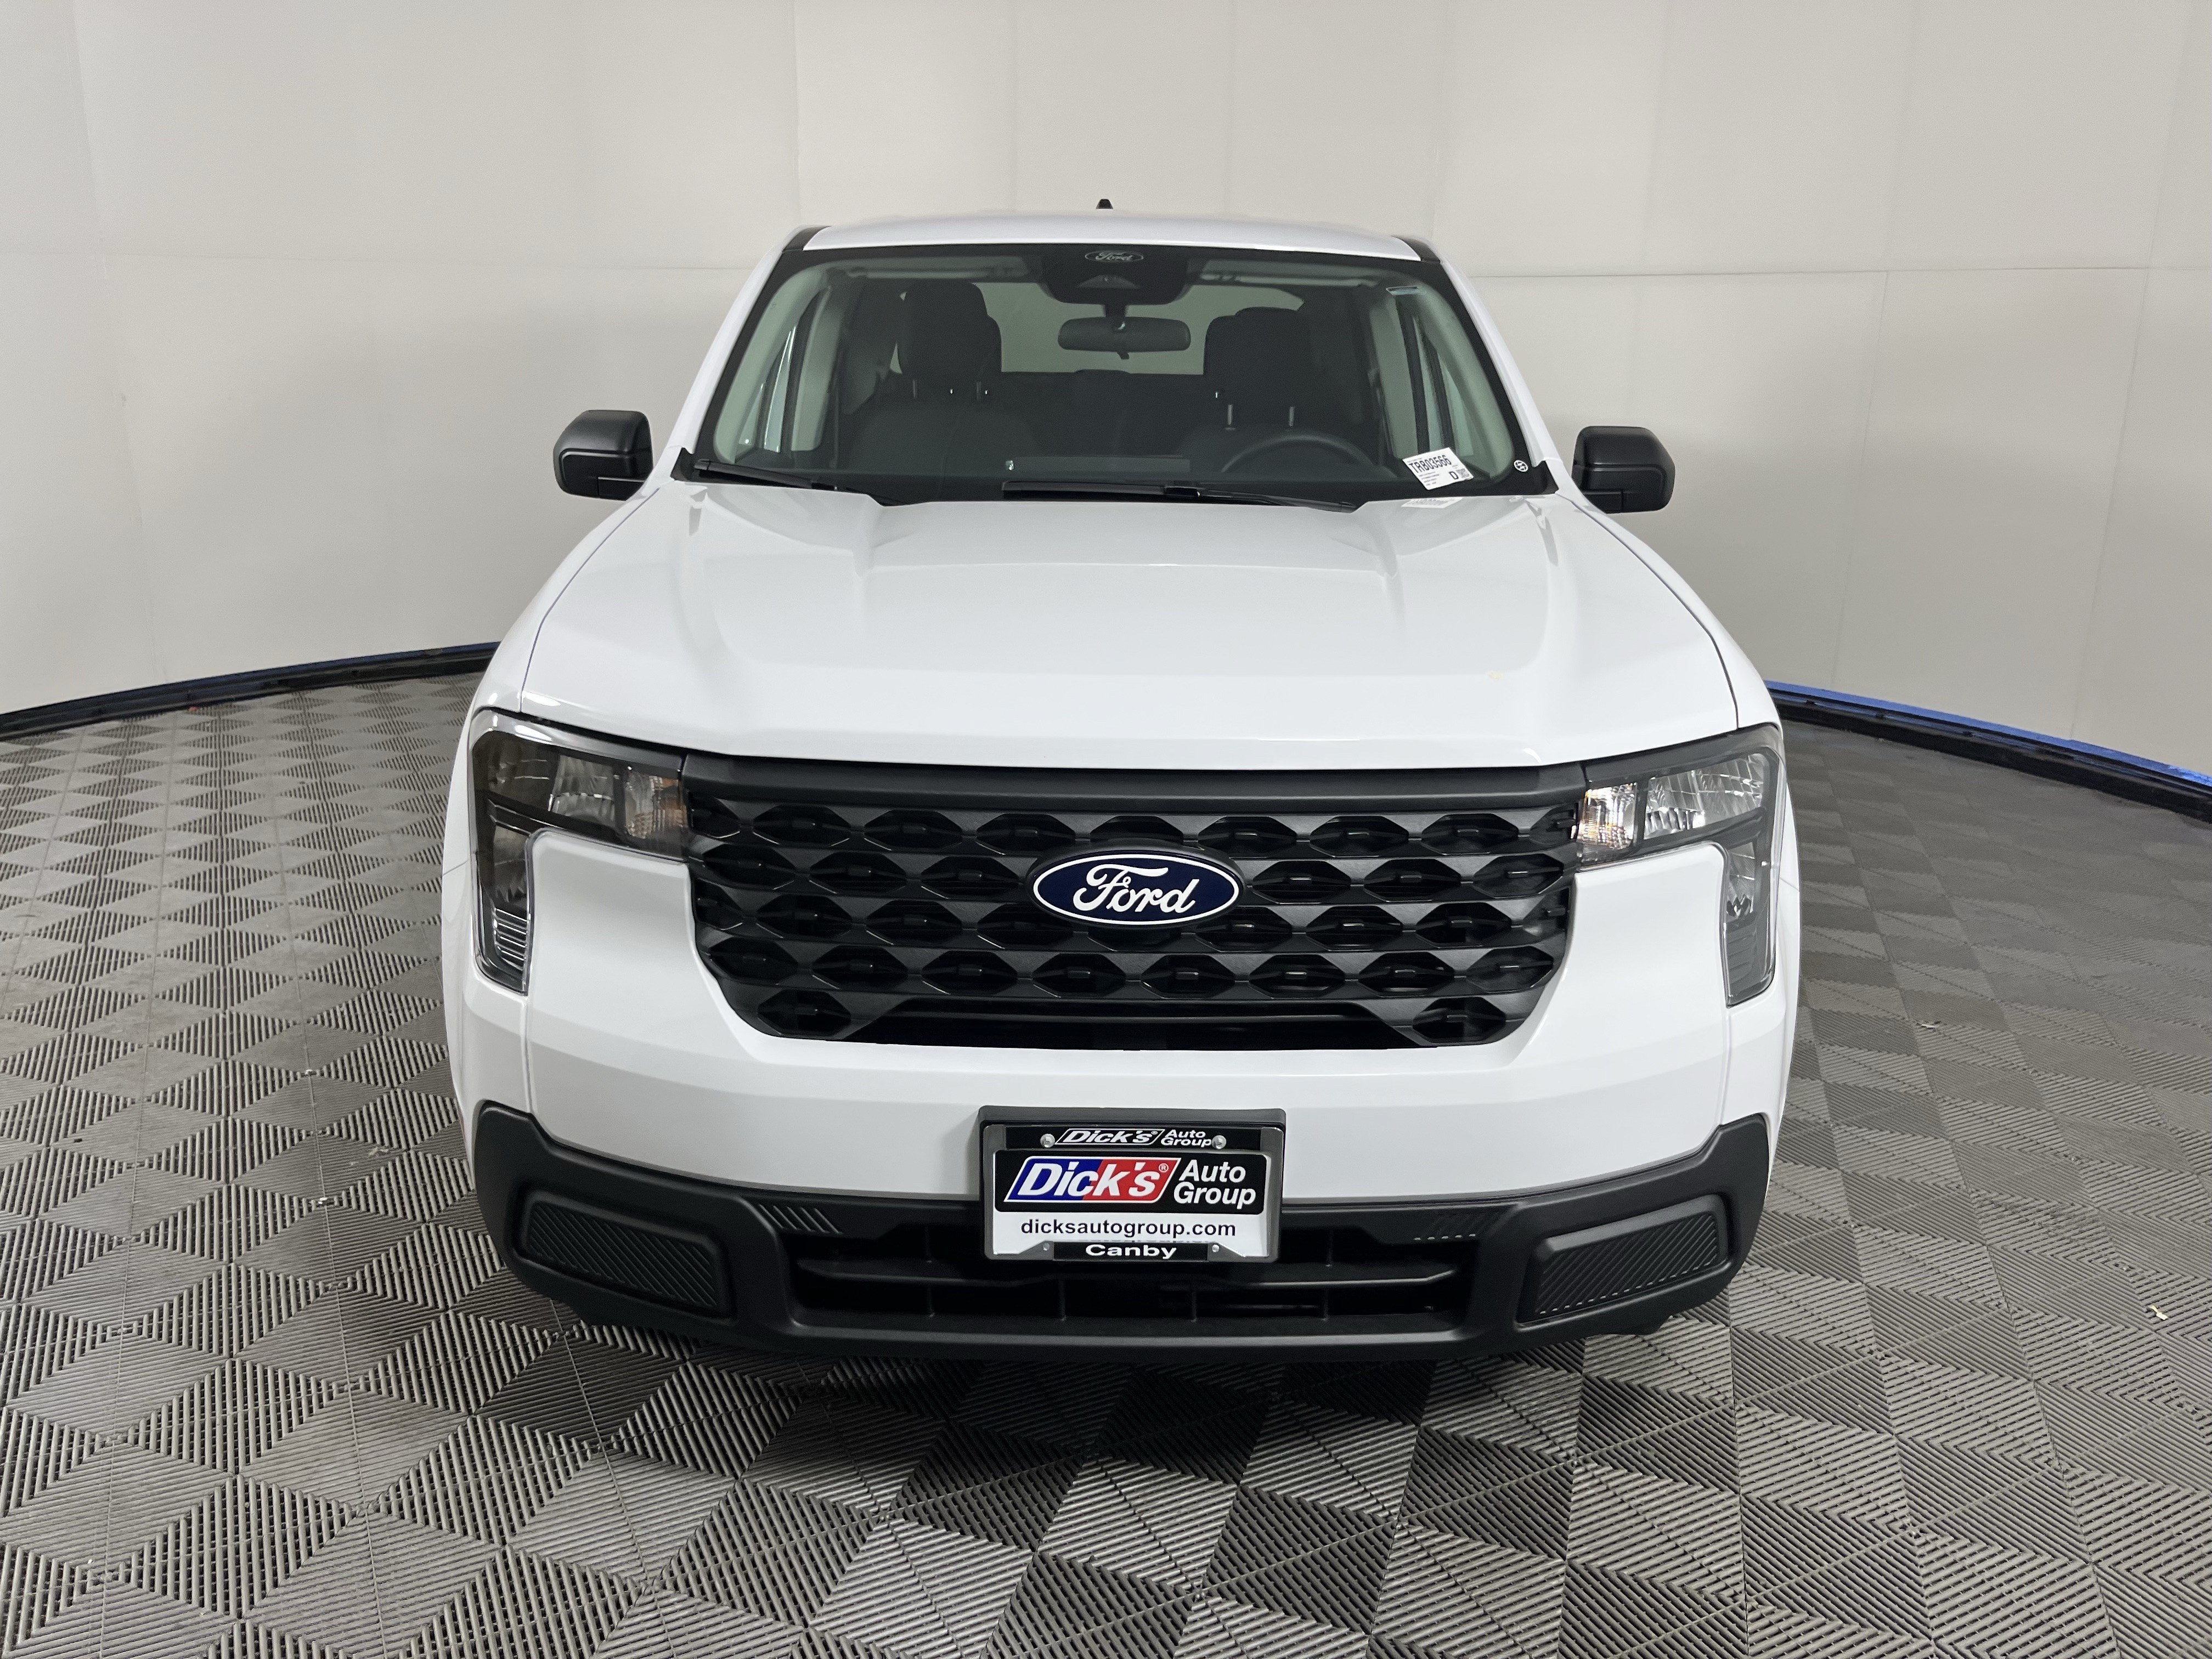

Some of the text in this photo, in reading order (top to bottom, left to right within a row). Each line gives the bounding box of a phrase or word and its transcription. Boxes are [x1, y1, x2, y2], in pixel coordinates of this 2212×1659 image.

[1073, 864, 1200, 913] Ford
[1160, 1136, 1211, 1148] Group
[1165, 1128, 1206, 1139] Auto
[1178, 1159, 1246, 1183] Auto
[1173, 1182, 1256, 1210] Group
[1021, 1218, 1236, 1238] dicksautogroup.com
[1085, 1244, 1177, 1259] Canby
